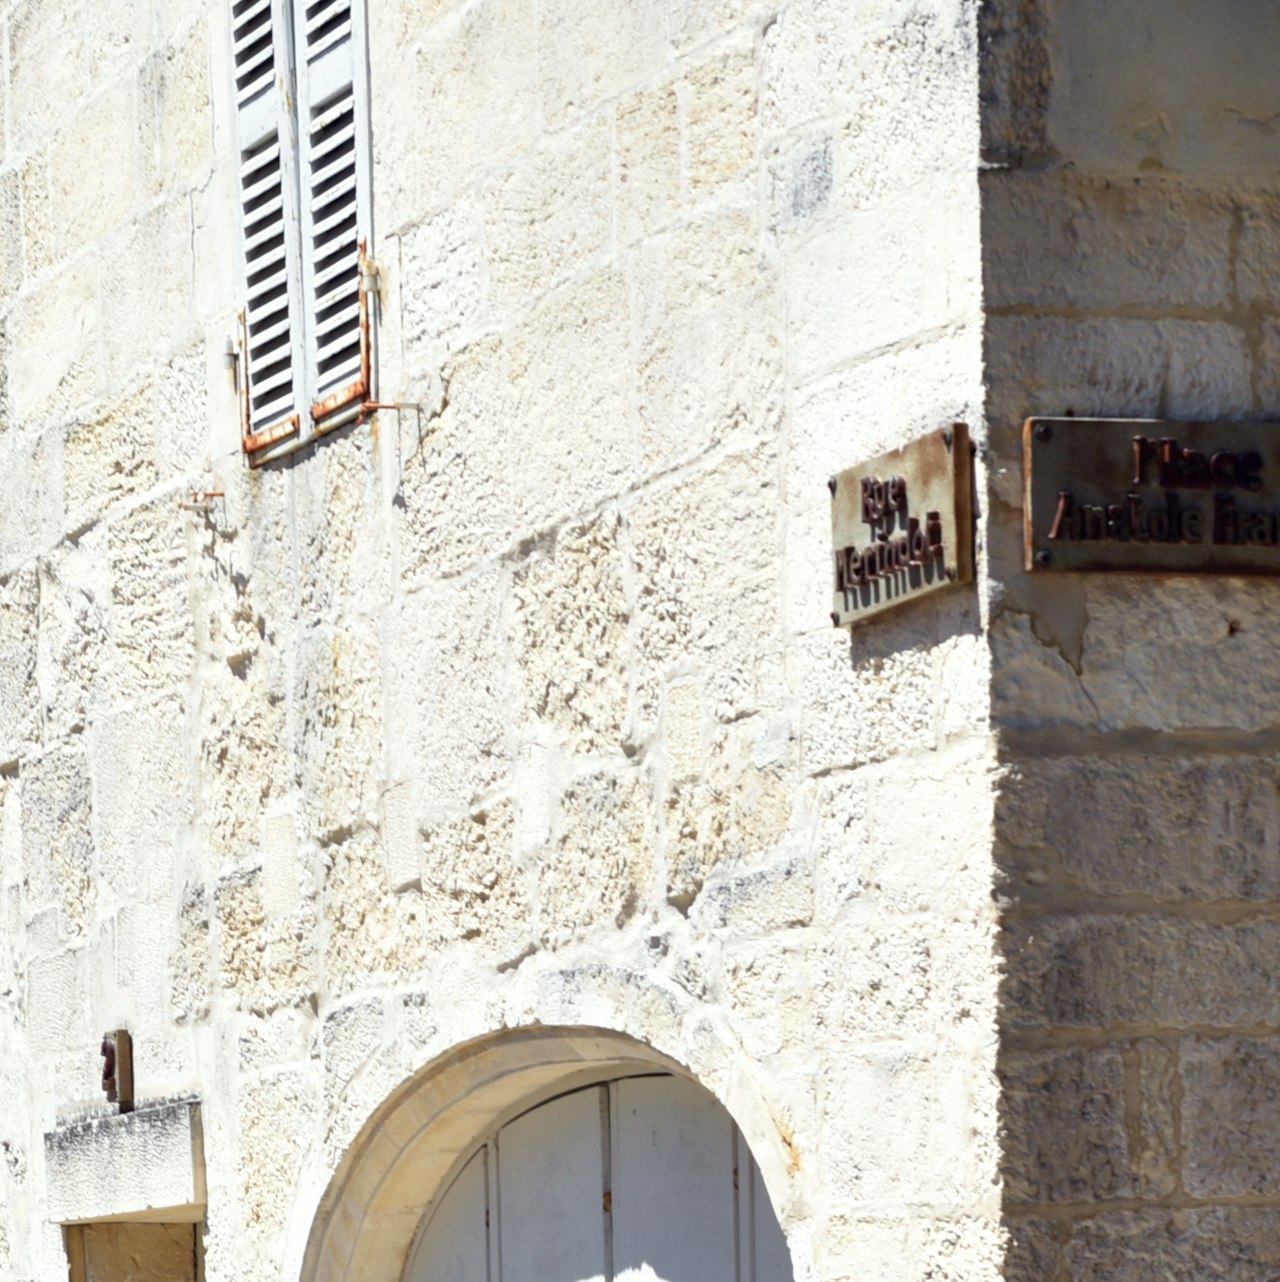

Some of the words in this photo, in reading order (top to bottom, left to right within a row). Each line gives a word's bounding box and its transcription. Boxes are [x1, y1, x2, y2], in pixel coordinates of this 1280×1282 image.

[1132, 435, 1262, 491] Place
[860, 475, 906, 522] Rue
[1047, 490, 1205, 543] Anatole
